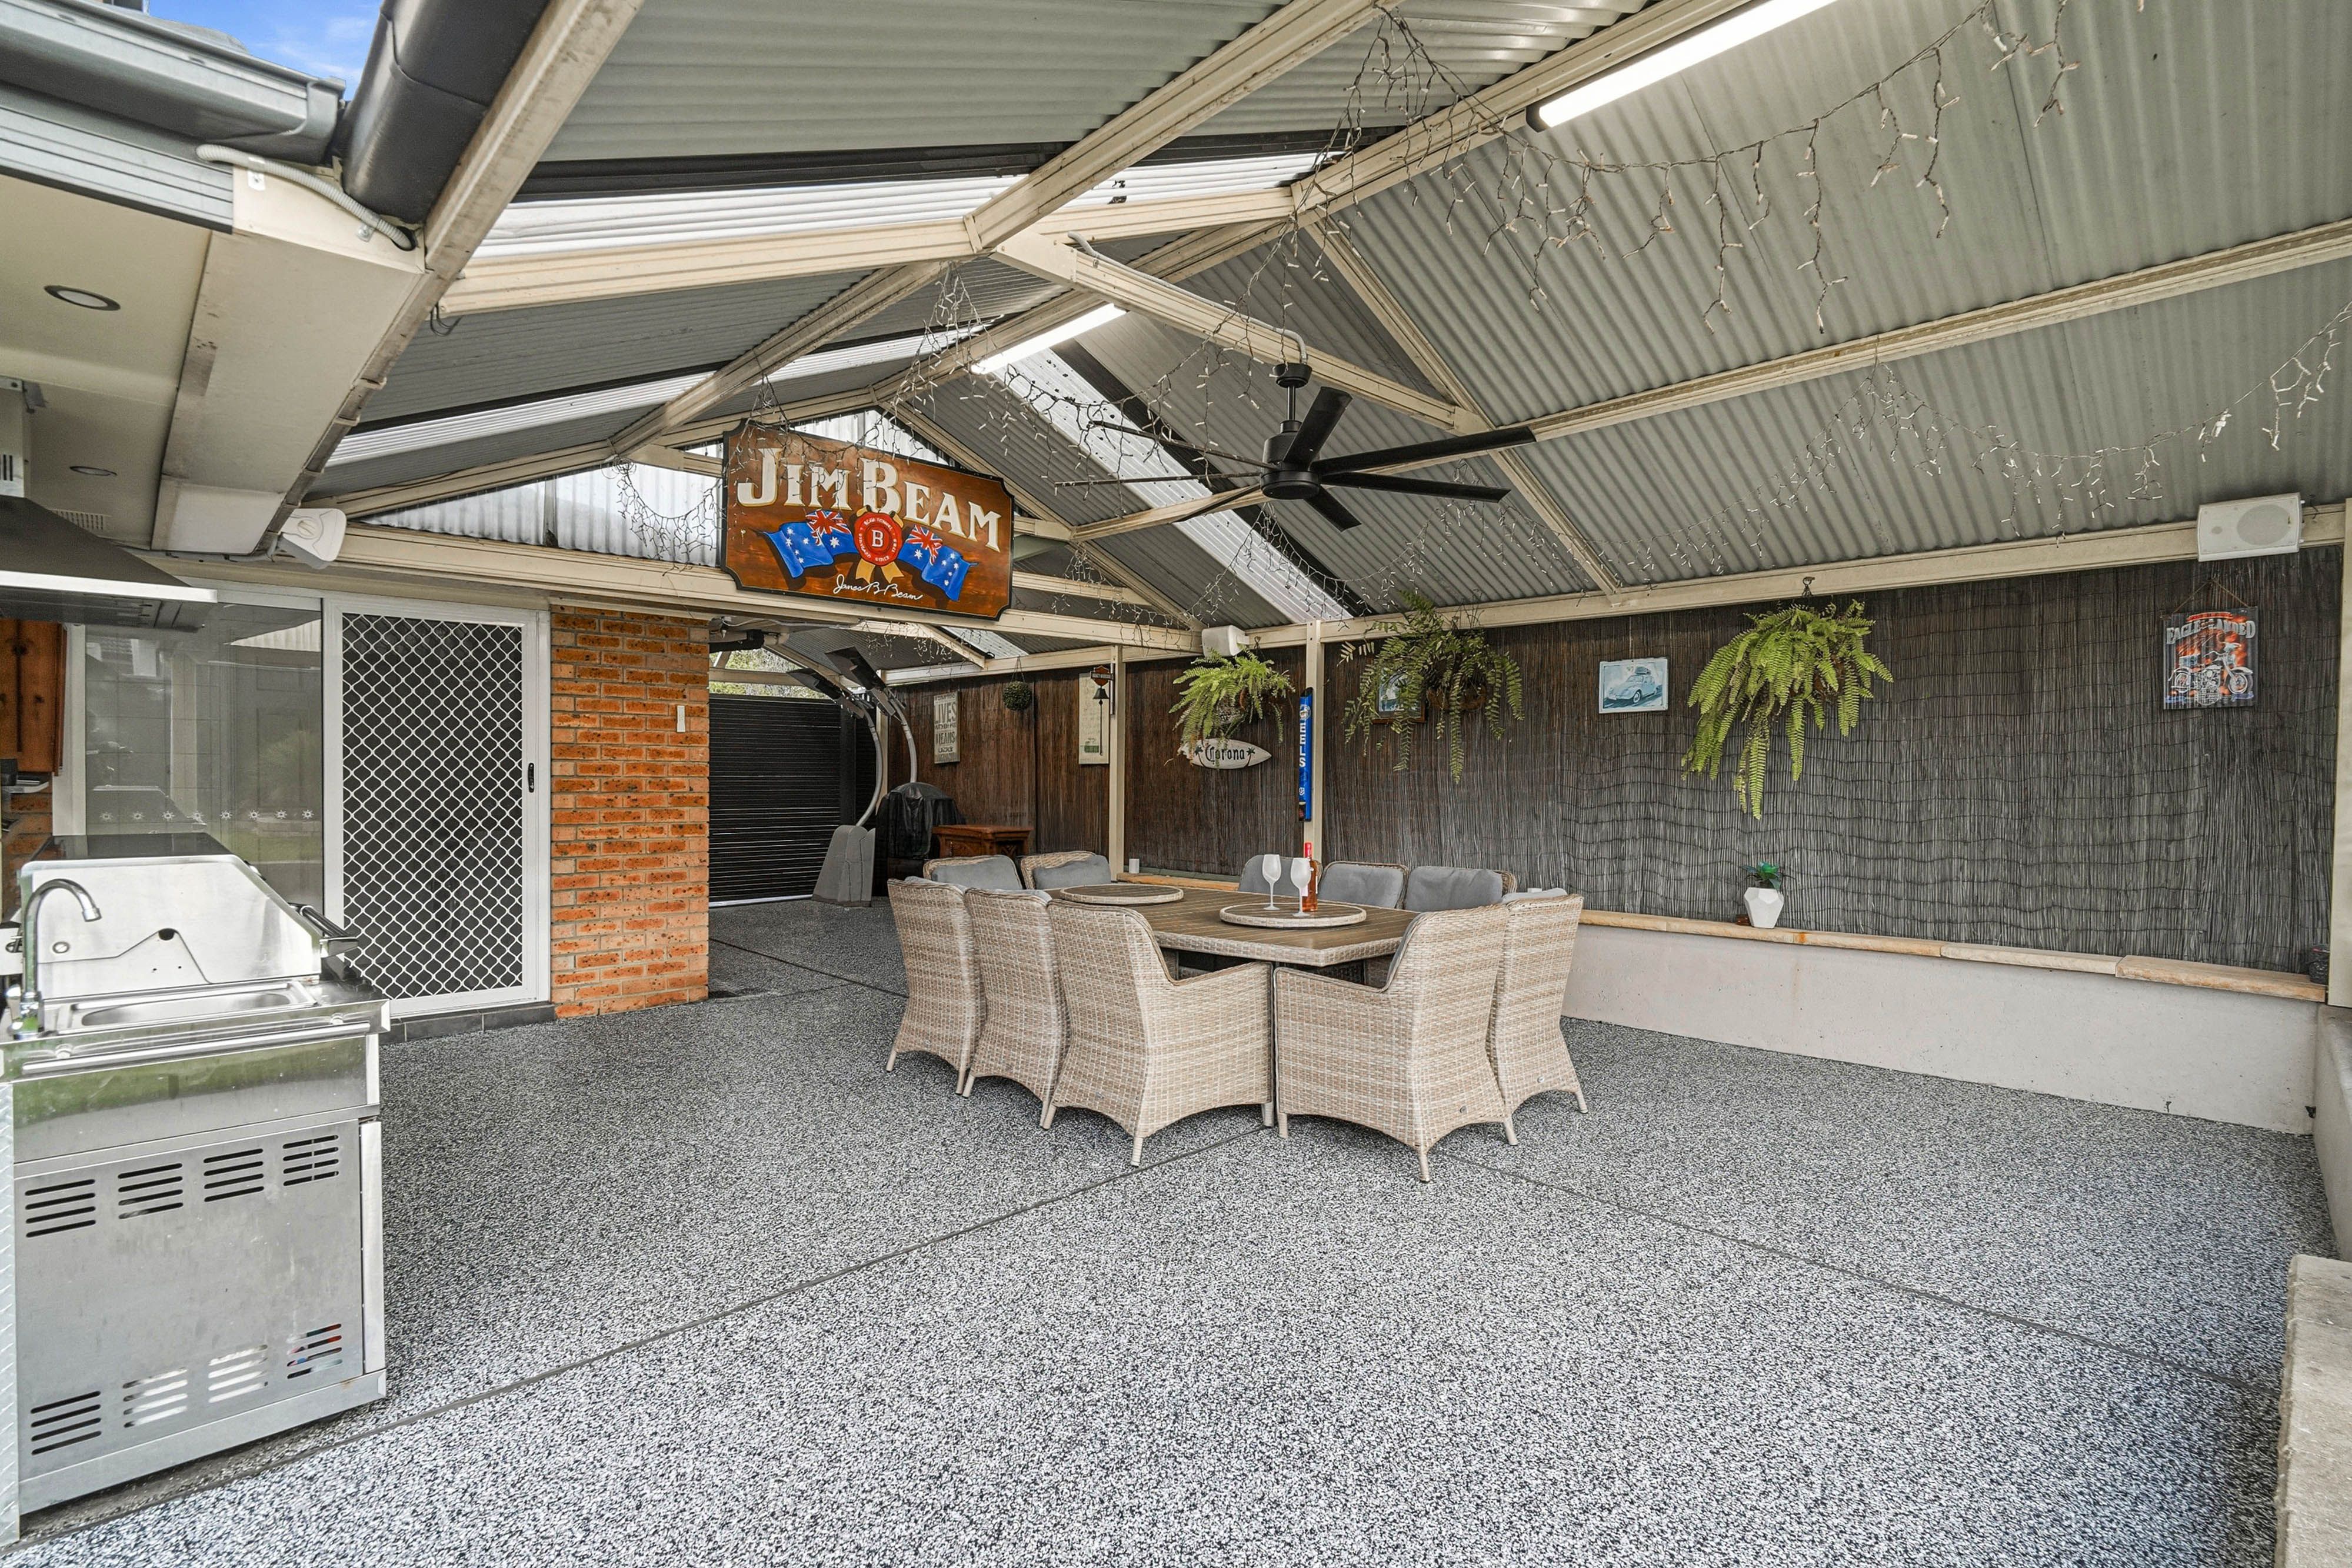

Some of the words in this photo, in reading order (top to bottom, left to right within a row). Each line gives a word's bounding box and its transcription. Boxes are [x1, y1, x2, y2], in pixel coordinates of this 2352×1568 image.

[737, 448, 852, 511] JIM
[860, 458, 1002, 553] BEAM
[871, 529, 884, 547] B
[2167, 619, 2201, 645] EAGLE
[1206, 744, 1245, 765] Corona
